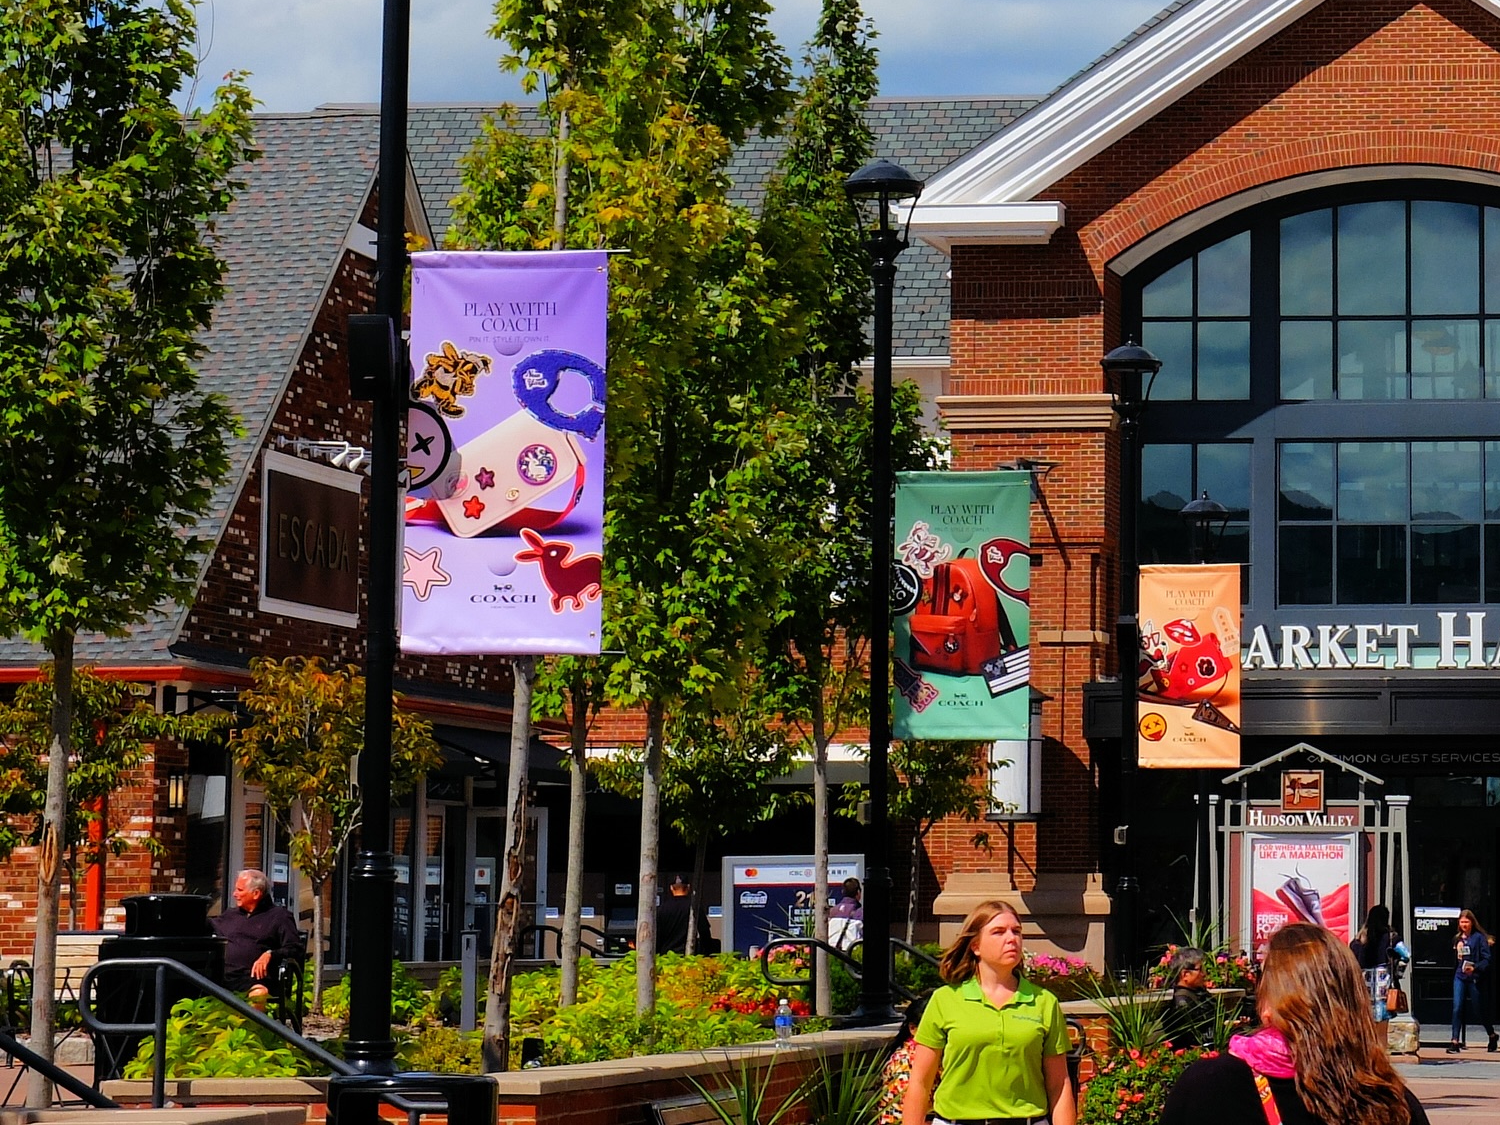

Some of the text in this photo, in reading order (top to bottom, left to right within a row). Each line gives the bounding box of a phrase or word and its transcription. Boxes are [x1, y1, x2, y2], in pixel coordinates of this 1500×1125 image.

[464, 302, 557, 317] PLAY WITH
[481, 317, 539, 332] COACH
[930, 504, 995, 515] PLAY WITH
[942, 515, 982, 525] COACH
[278, 513, 350, 573] ESCADA
[470, 594, 536, 603] COACH
[1166, 590, 1186, 598] PLAY
[1241, 624, 1419, 668] ARKET
[1380, 754, 1428, 763] GUEST
[1431, 753, 1500, 763] SERVICES
[1249, 810, 1354, 826] HUDSON VALLEY
[1259, 851, 1343, 860] LIKE A MARATHON
[1256, 913, 1288, 923] FRESH
